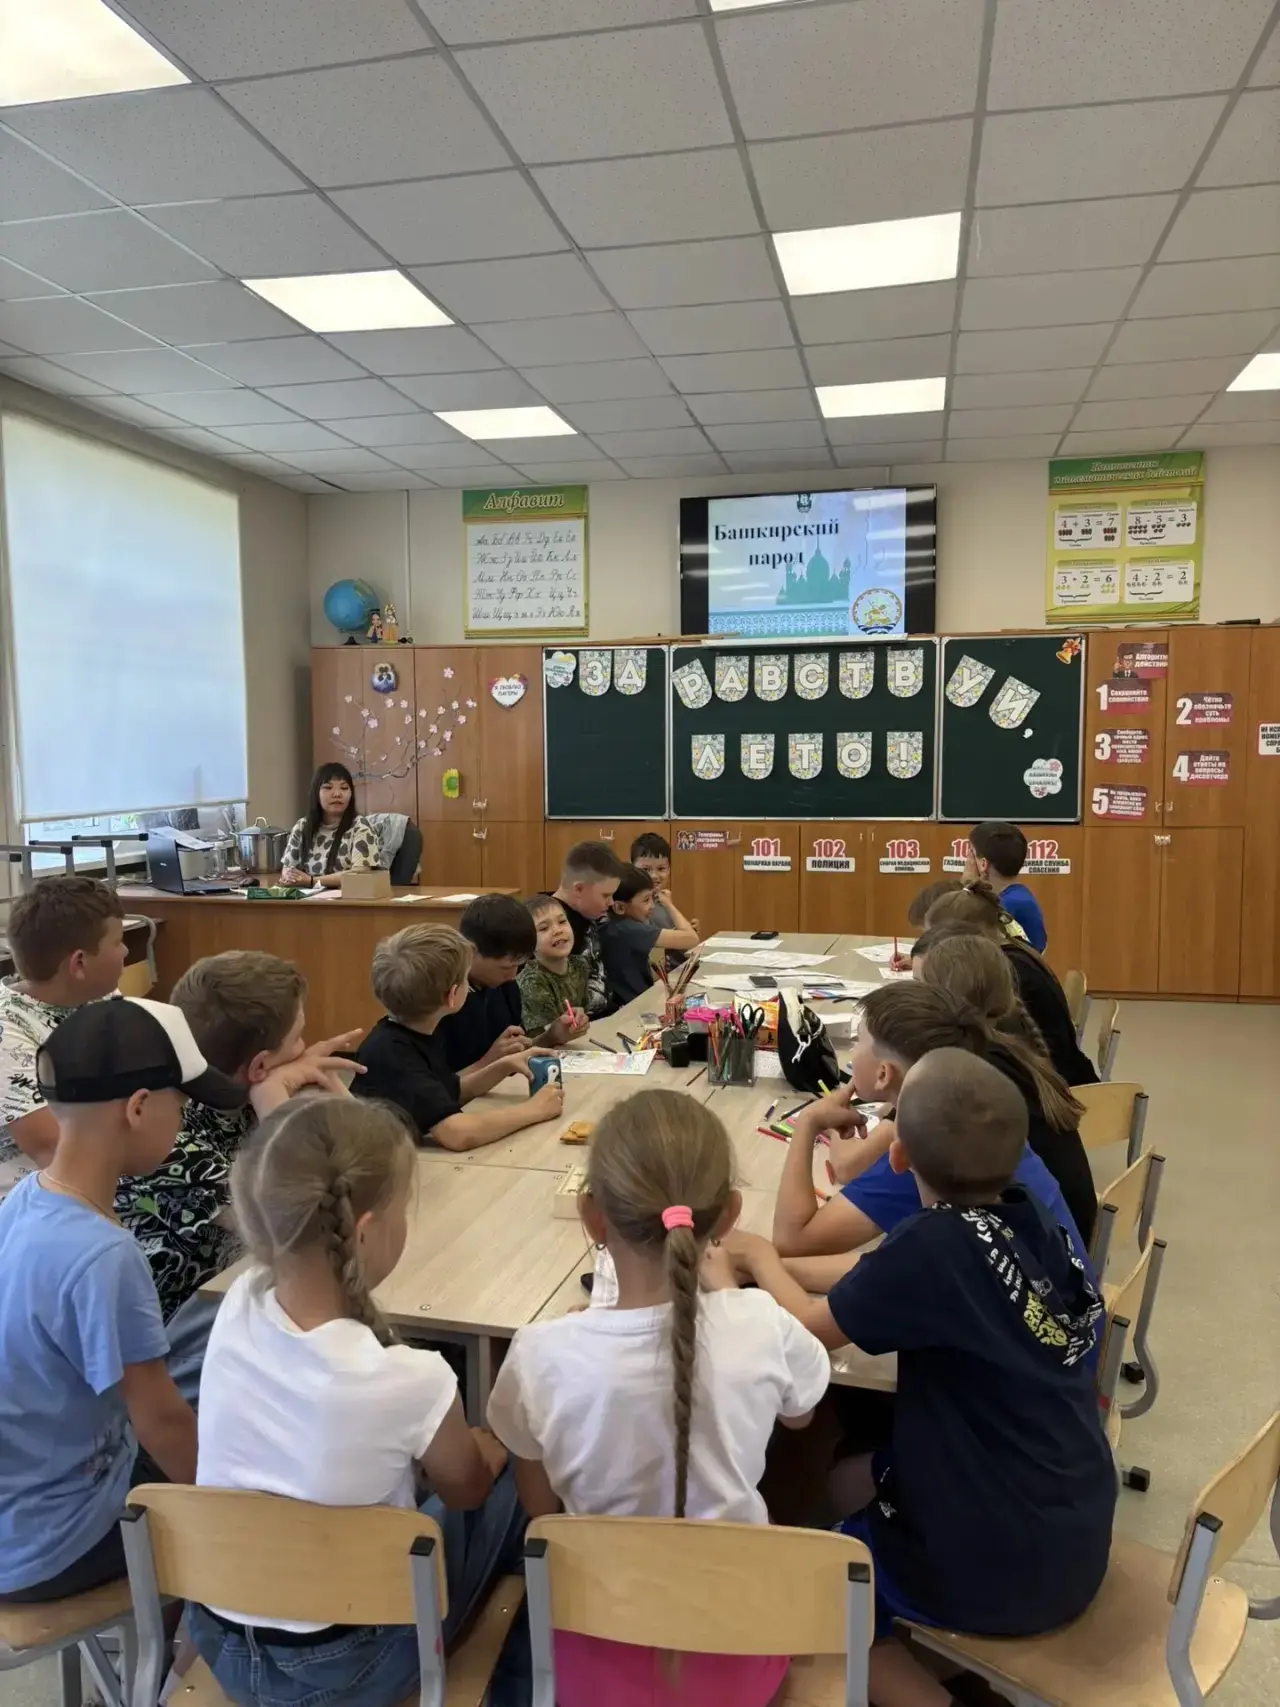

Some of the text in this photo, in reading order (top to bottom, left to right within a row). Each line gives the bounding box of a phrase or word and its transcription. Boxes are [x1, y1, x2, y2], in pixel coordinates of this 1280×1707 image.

[484, 491, 563, 514] Алфавит
[1084, 518, 1091, 527] 3
[1107, 517, 1115, 526] 7
[1180, 513, 1187, 522] 3
[715, 518, 840, 542] Башкирский
[749, 551, 804, 569] народ
[1061, 575, 1068, 584] 3
[1082, 575, 1089, 584] 2
[1105, 574, 1112, 583] 6
[1132, 573, 1139, 582] 4
[1154, 572, 1161, 581] 2
[1179, 571, 1187, 580] 2
[1096, 684, 1108, 710] 1
[1176, 698, 1192, 725] 2
[696, 741, 908, 770] ЛЕТО!
[1094, 733, 1111, 760] 3
[1172, 755, 1189, 781] 4
[1092, 788, 1109, 815] 5
[752, 839, 780, 857] 101
[813, 839, 846, 858] 102
[886, 839, 920, 859] 103
[951, 839, 970, 858] 10
[1027, 839, 1059, 860] 112
[811, 859, 850, 869] ПОЛИЦИЯ
